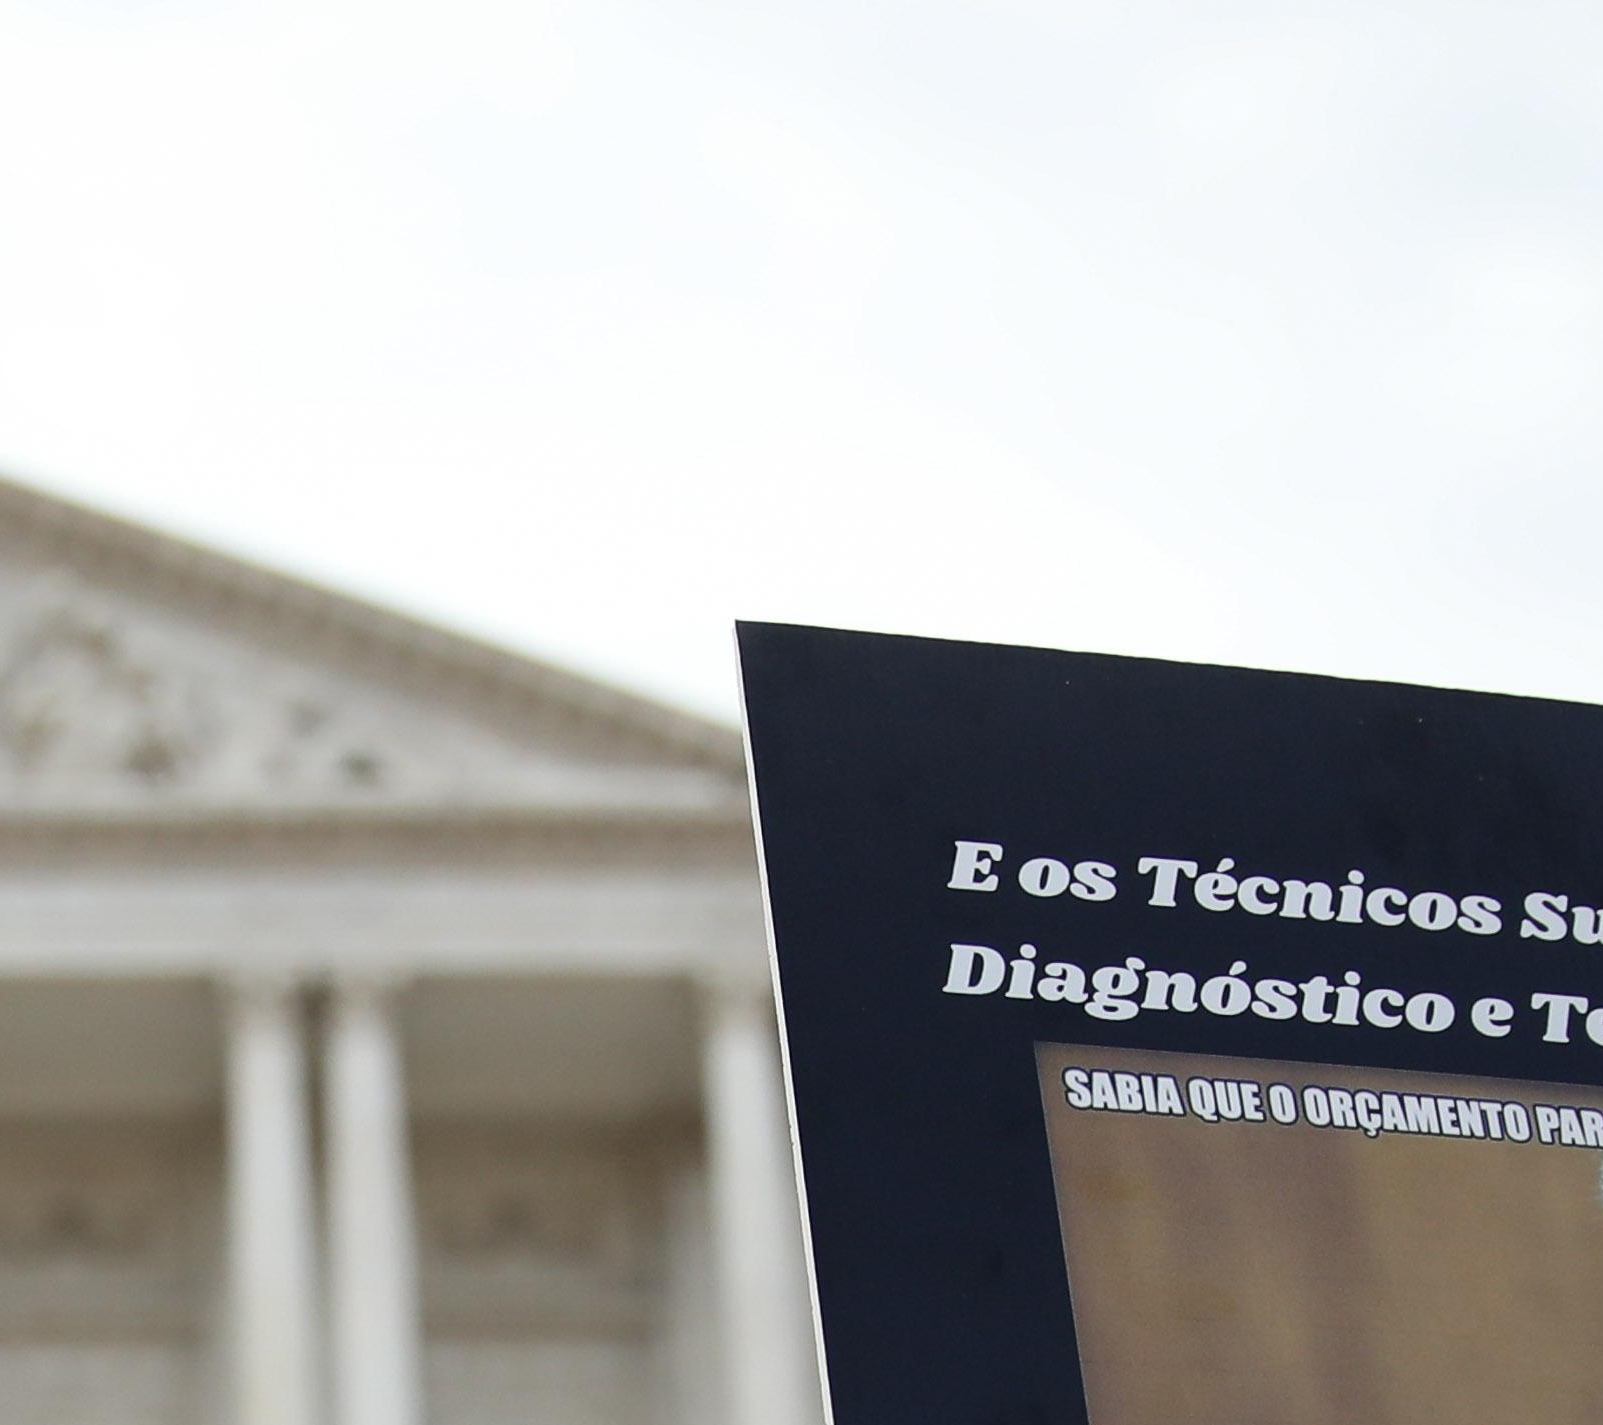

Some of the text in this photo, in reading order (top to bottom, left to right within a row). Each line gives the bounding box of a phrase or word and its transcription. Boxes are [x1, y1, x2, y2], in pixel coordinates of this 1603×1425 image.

[948, 840, 1003, 892] E
[1018, 857, 1117, 901] os
[1138, 857, 1502, 935] Técnicos
[942, 943, 1455, 1032] Diagnóstico
[1470, 997, 1514, 1037] e
[1063, 1068, 1184, 1115] SABIA
[1188, 1078, 1264, 1122] QUE
[1269, 1085, 1296, 1124] O
[1303, 1088, 1531, 1142] ORÇAMENTO
